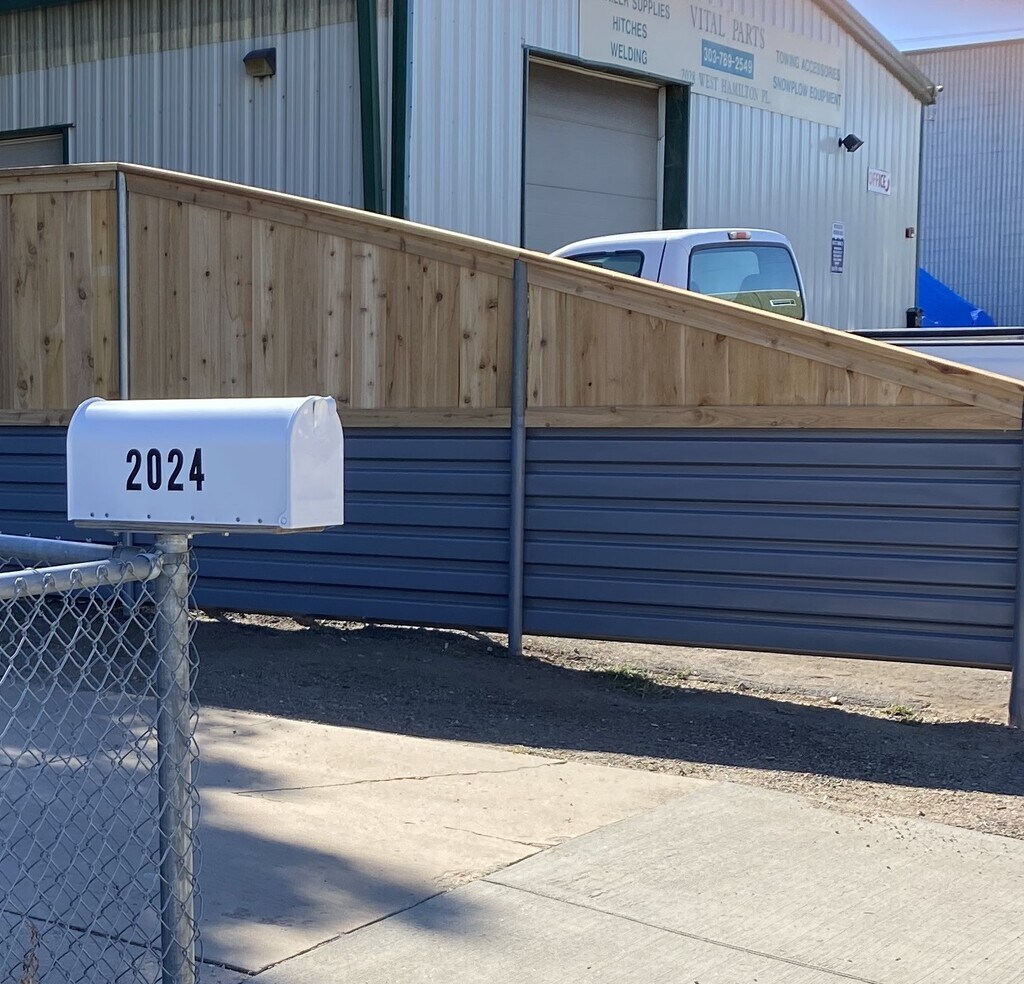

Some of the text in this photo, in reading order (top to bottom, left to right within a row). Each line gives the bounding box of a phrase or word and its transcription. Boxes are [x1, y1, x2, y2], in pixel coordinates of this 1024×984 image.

[632, 0, 670, 19] SUPPLIES
[613, 16, 647, 39] HITCHES
[690, 5, 765, 49] VITAL PARTS
[611, 41, 647, 65] WELDING
[776, 50, 840, 81] TOWING ACCESSORIES
[698, 72, 719, 91] WEST
[721, 78, 759, 101] HAMILTON
[773, 76, 841, 106] SNOWPLOW EQUIPMENT
[126, 448, 204, 491] 2024
